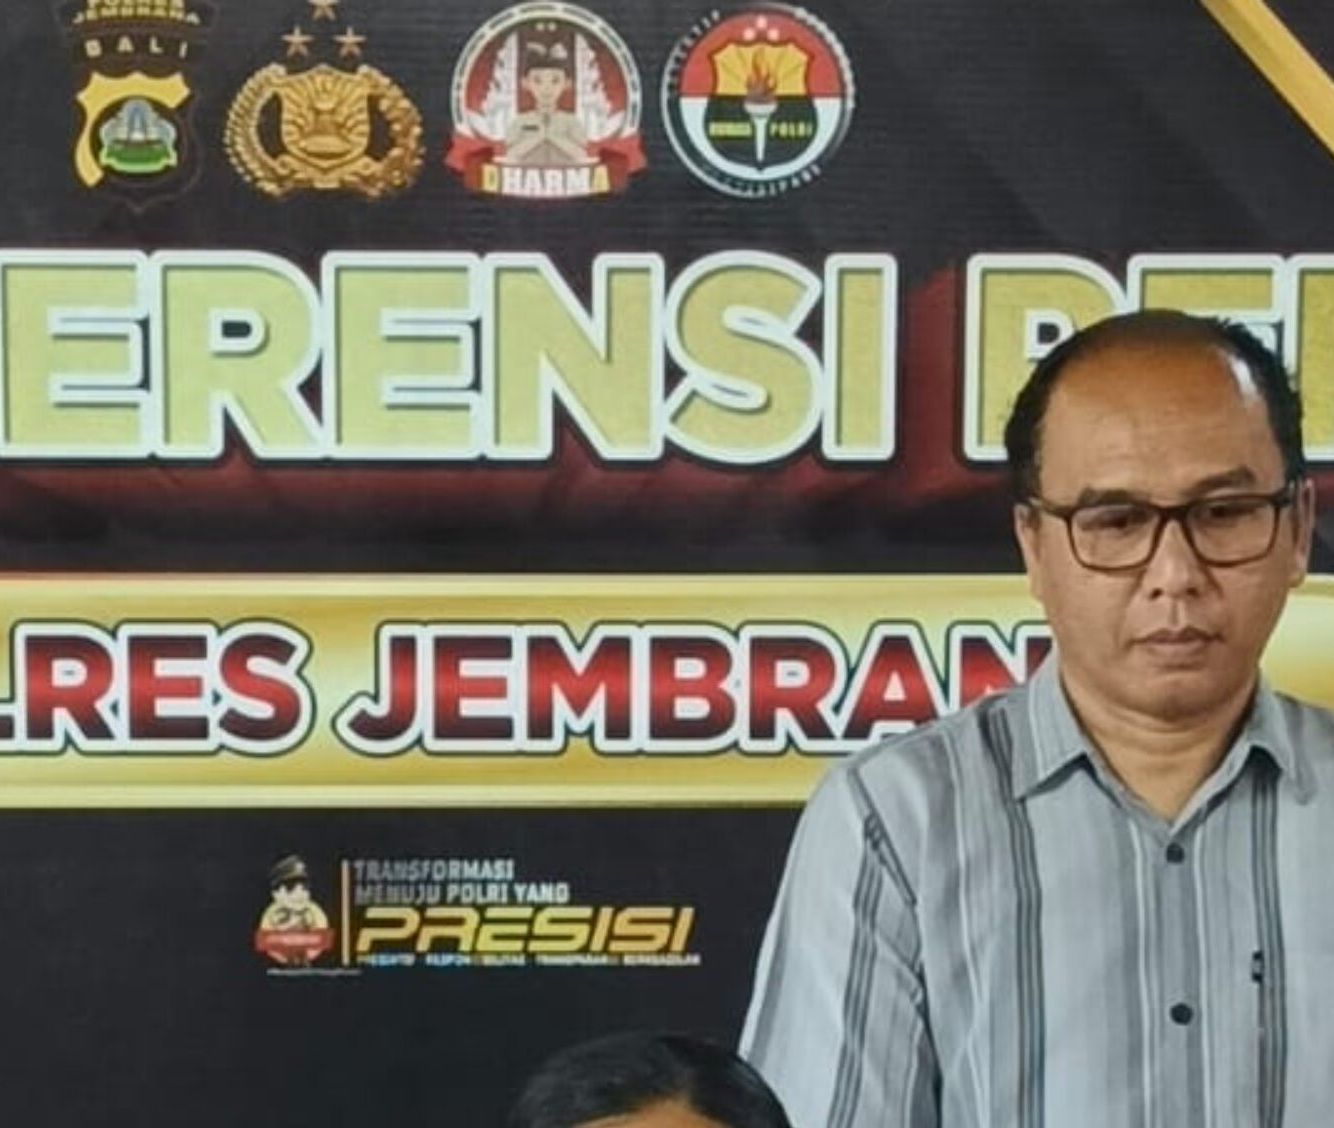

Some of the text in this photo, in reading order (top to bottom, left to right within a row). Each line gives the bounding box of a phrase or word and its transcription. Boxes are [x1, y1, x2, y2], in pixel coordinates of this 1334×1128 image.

[84, 36, 188, 58] BALI
[481, 163, 611, 197] DHARMA
[331, 620, 1059, 757] JEMBRAN
[353, 859, 515, 880] TRANSFORMASI
[354, 881, 441, 904] MENUJU
[446, 881, 510, 904] POLRI
[355, 906, 696, 953] PRESISI
